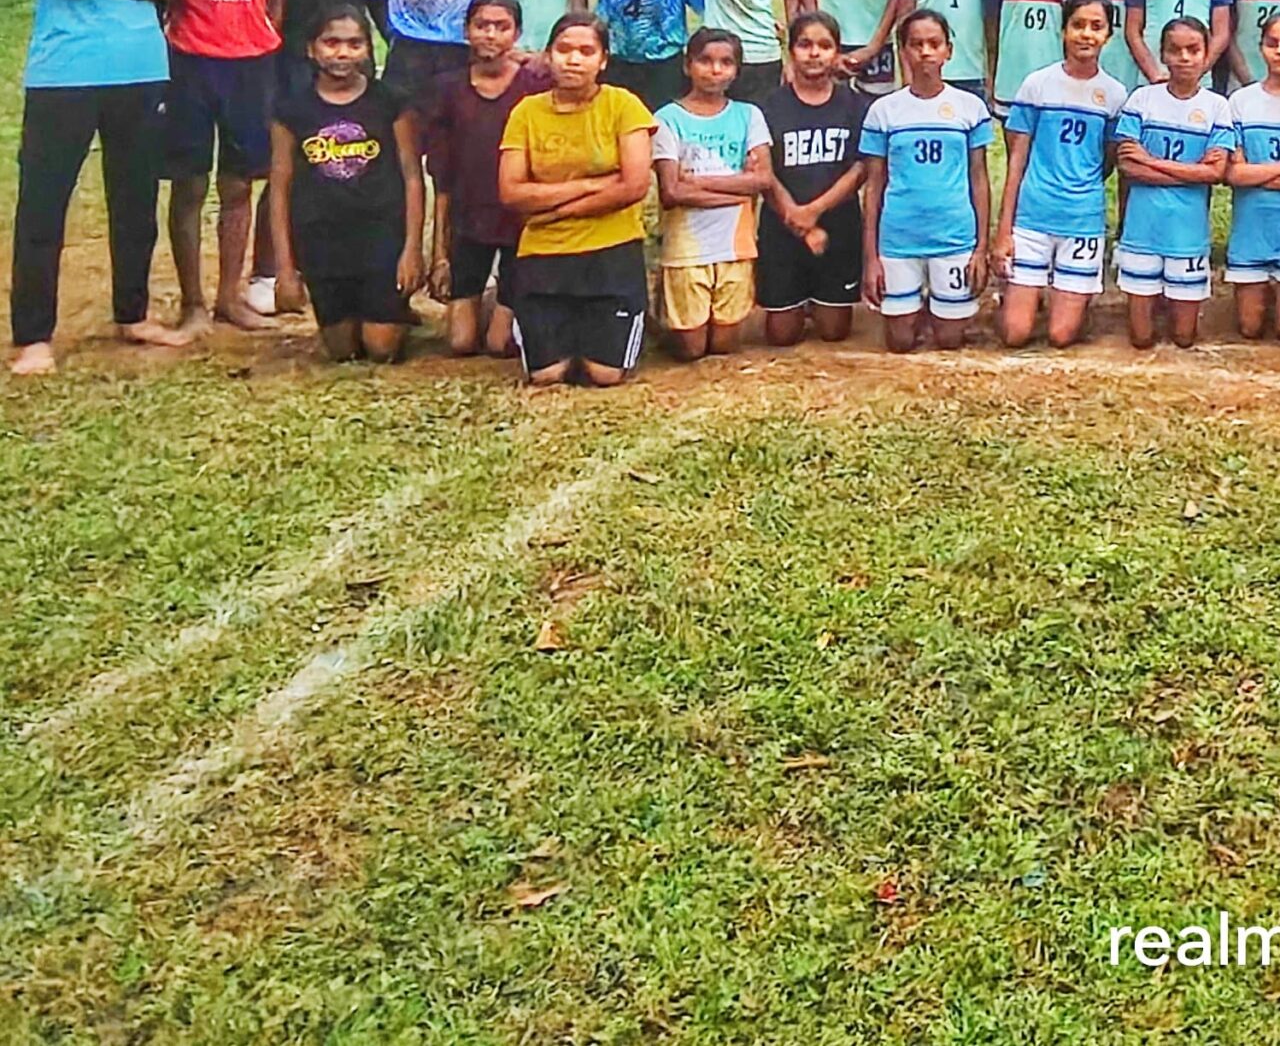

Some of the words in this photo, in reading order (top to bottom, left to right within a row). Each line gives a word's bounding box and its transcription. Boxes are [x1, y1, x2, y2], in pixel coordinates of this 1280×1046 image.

[1024, 7, 1047, 30] 69
[1060, 118, 1087, 146] 29
[783, 128, 850, 167] BEAST
[914, 138, 943, 164] 38
[1072, 237, 1098, 260] 29
